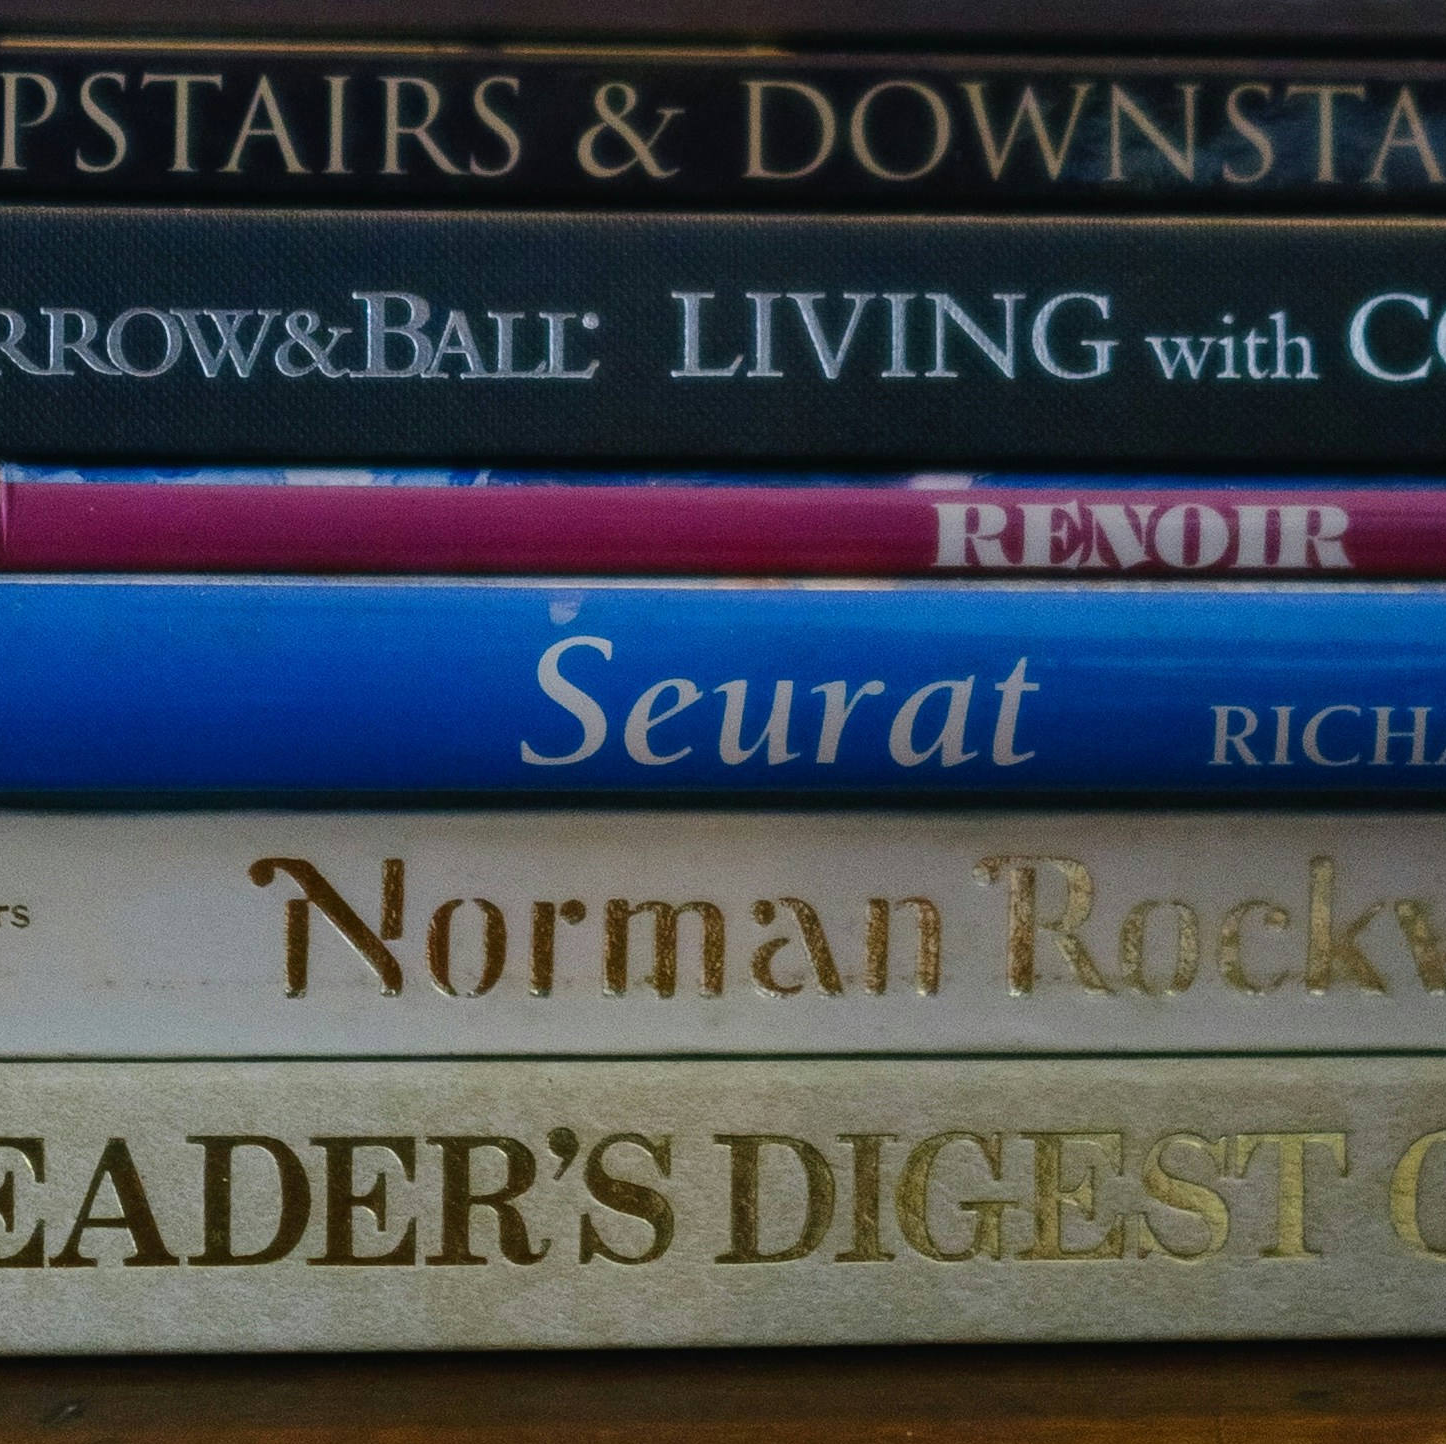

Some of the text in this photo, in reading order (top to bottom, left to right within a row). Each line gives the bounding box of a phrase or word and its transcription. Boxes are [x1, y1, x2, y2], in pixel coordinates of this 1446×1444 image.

[576, 82, 685, 180] &
[670, 290, 1120, 382] LIVING
[1143, 310, 1319, 382] with
[931, 500, 1351, 570] RENOIR
[519, 635, 1040, 768] Seurat
[247, 856, 943, 1000] Norman
[713, 1130, 1349, 1264] DIGEST
